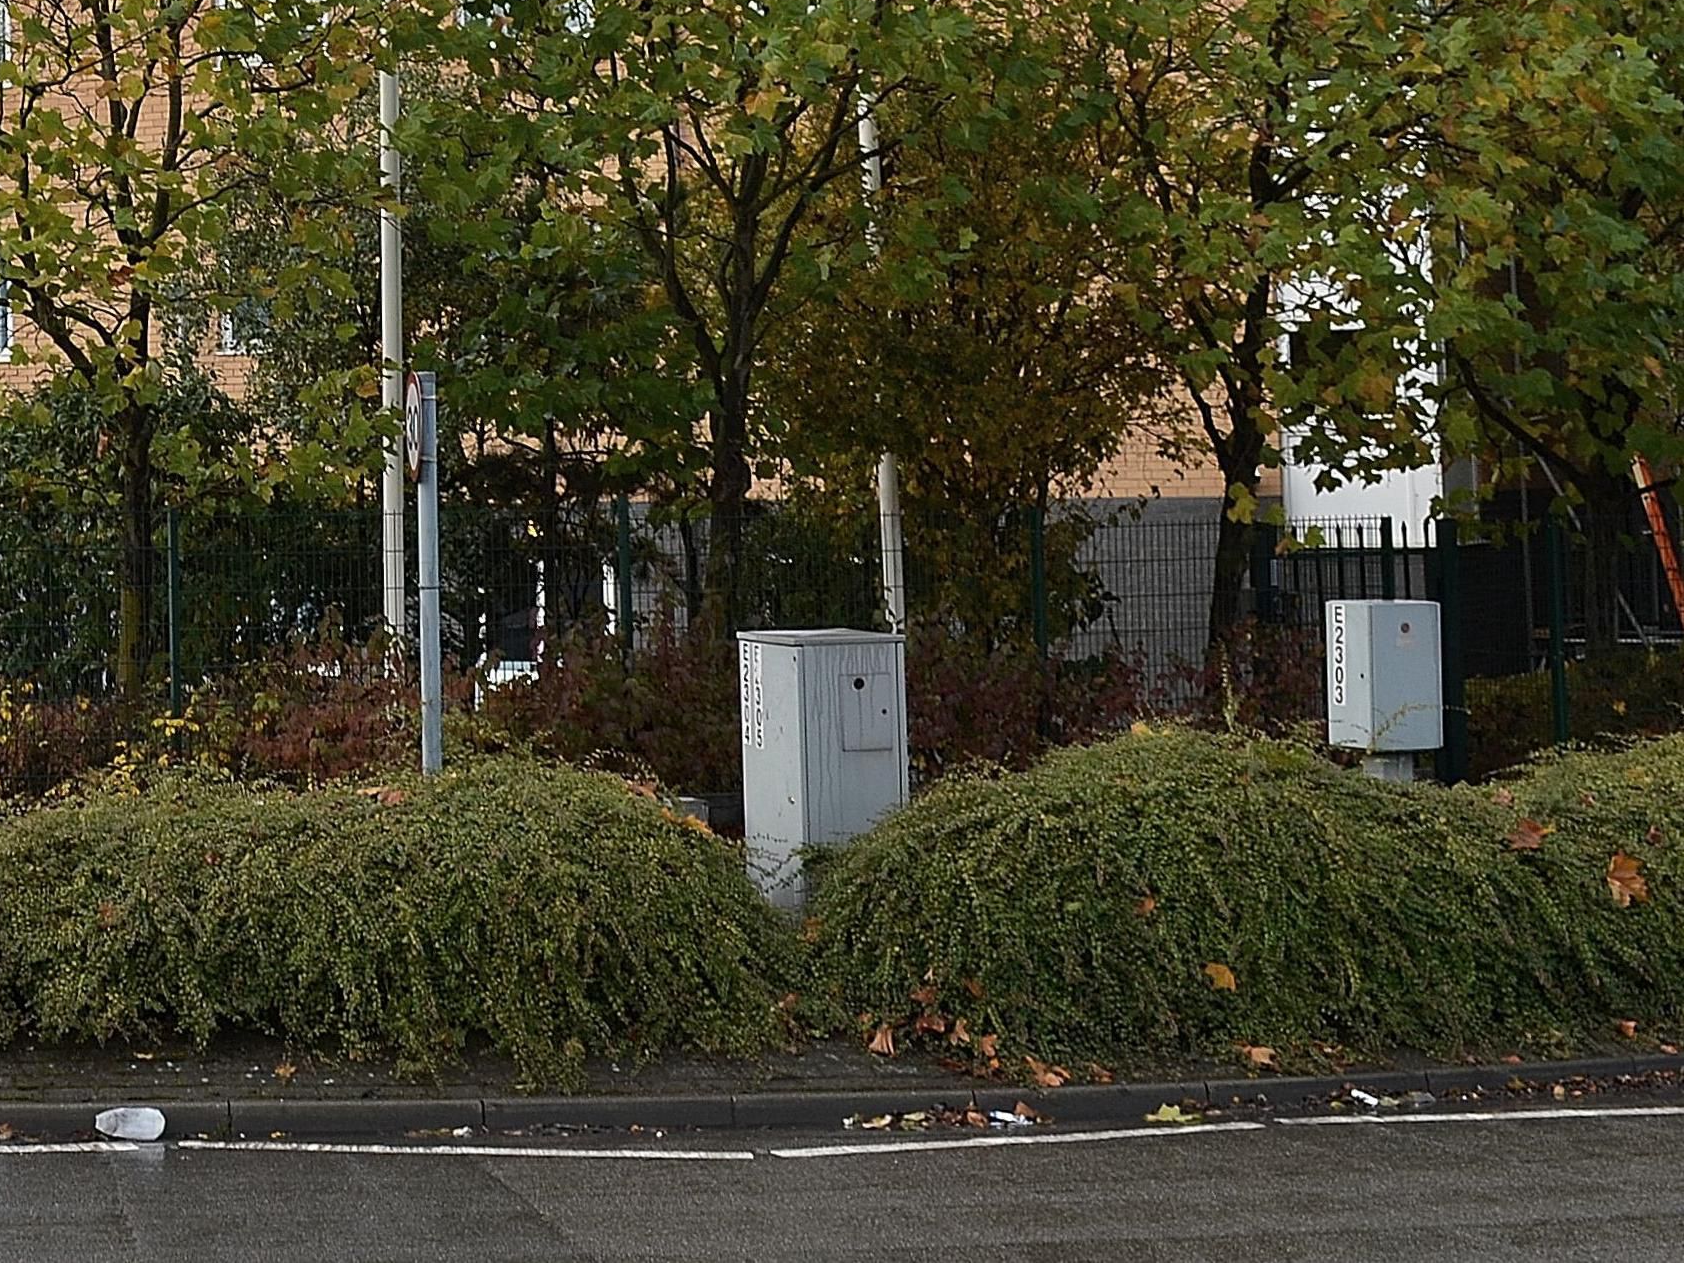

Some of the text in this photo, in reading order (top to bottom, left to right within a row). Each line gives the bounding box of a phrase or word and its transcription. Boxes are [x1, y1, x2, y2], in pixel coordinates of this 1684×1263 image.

[406, 405, 420, 451] 30
[753, 644, 764, 749] E305
[1333, 605, 1345, 705] E2303
